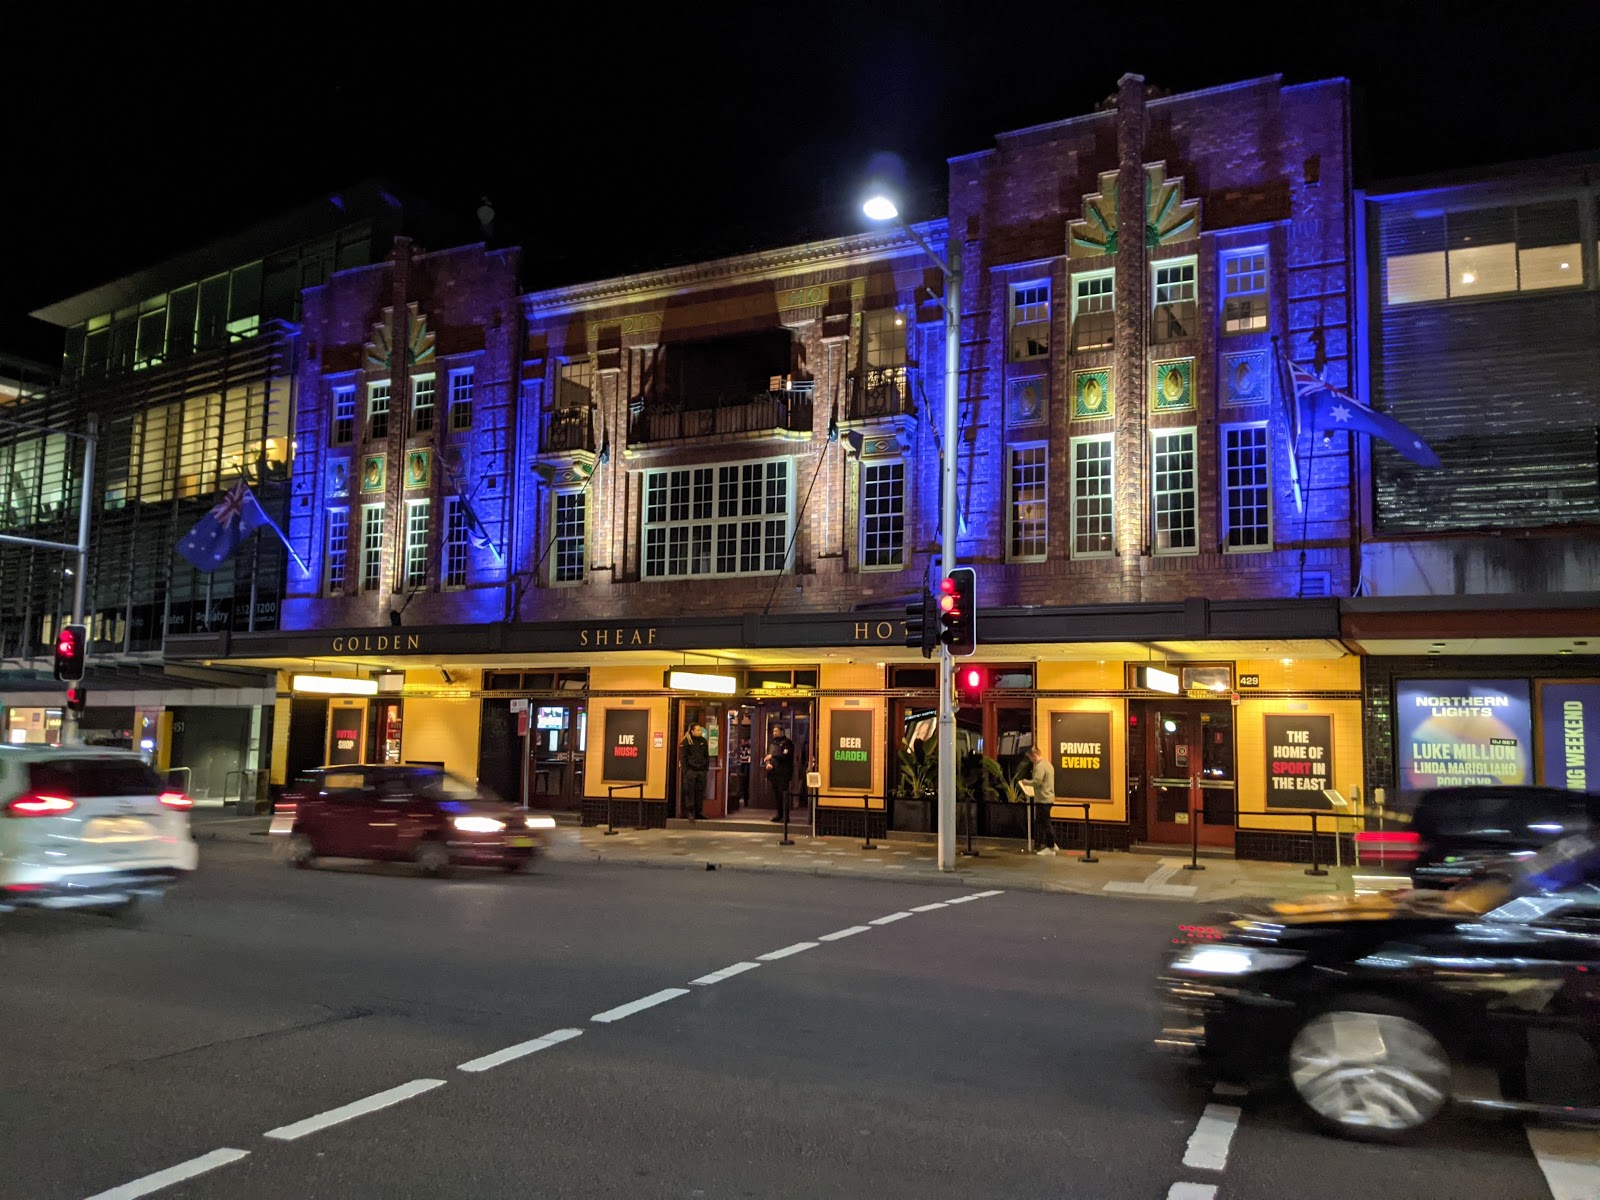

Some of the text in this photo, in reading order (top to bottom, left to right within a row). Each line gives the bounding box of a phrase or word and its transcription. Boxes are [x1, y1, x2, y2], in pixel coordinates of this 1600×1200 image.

[333, 634, 419, 652] GOLDEN
[580, 628, 656, 646] SHEAF
[1240, 676, 1259, 685] 429
[1415, 696, 1509, 707] NORTHERN
[1431, 707, 1493, 717] LIGHTS
[618, 734, 635, 745] LIVE
[1286, 730, 1309, 743] THE
[1563, 701, 1585, 767] WEEKEND
[337, 739, 354, 750] SHOP
[840, 737, 861, 748] BEER
[1060, 742, 1101, 754] PRIVATE
[614, 746, 638, 757] MUSIC
[834, 750, 867, 762] GARDEN
[1273, 745, 1324, 759] HOME OF
[1412, 743, 1516, 760] LUKE MILLION
[1061, 756, 1100, 769] EVENTS
[1272, 761, 1326, 775] SPORT IN
[1413, 761, 1517, 776] LINDA MARIGLIANO
[1272, 776, 1326, 791] THE EAST
